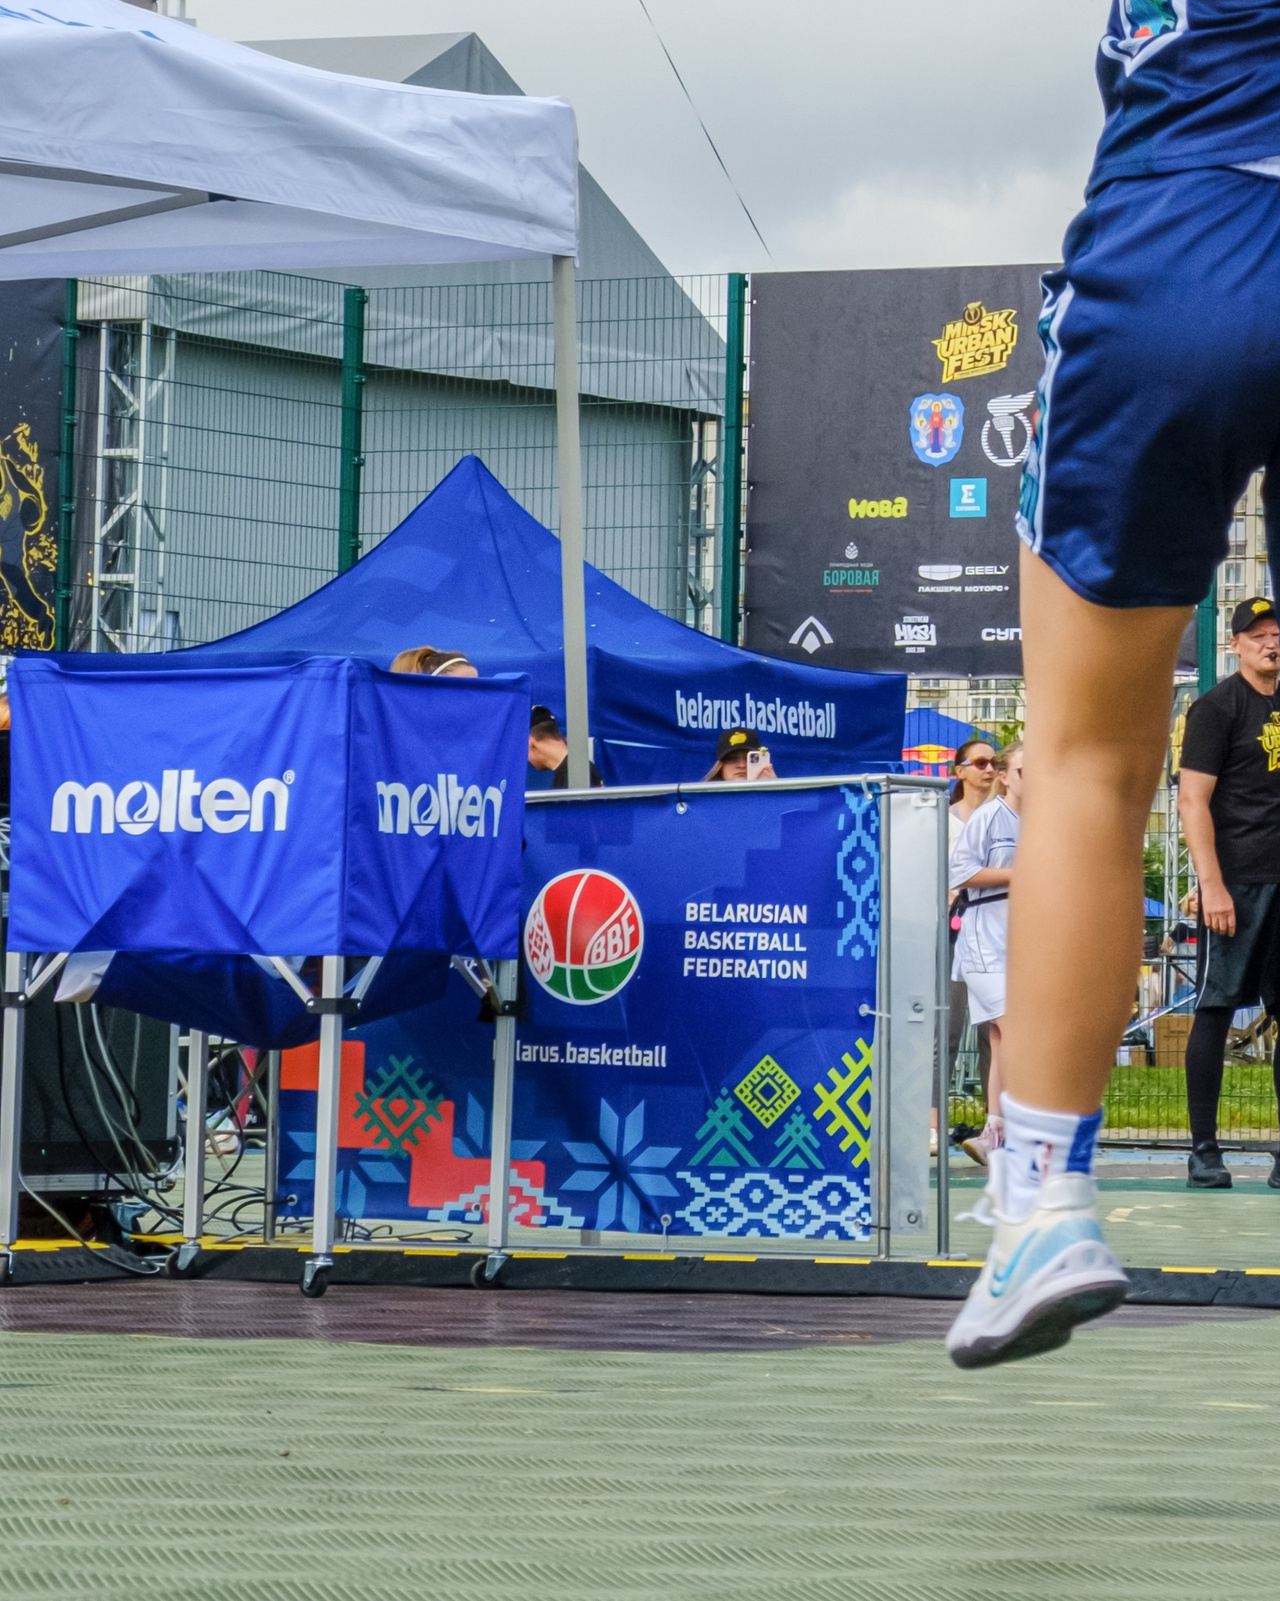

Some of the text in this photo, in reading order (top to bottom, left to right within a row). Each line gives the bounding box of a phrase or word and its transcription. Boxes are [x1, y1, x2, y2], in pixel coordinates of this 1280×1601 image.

[944, 311, 1010, 341] MINSK
[940, 326, 1013, 358] URBAN
[947, 343, 1007, 377] FEST
[823, 569, 880, 586] БОРОВАЯ
[965, 565, 1010, 575] GEELY
[918, 585, 962, 593] ЛАКШЕРИ
[675, 689, 836, 739] belarus.basketball
[50, 769, 289, 836] molten
[376, 773, 503, 838] molten
[685, 902, 807, 924] BELARUSIAN
[590, 907, 635, 965] BBF
[684, 930, 807, 952] BASKETBALL
[683, 957, 807, 980] FEDERATION
[493, 1039, 667, 1068] larus.basketball
